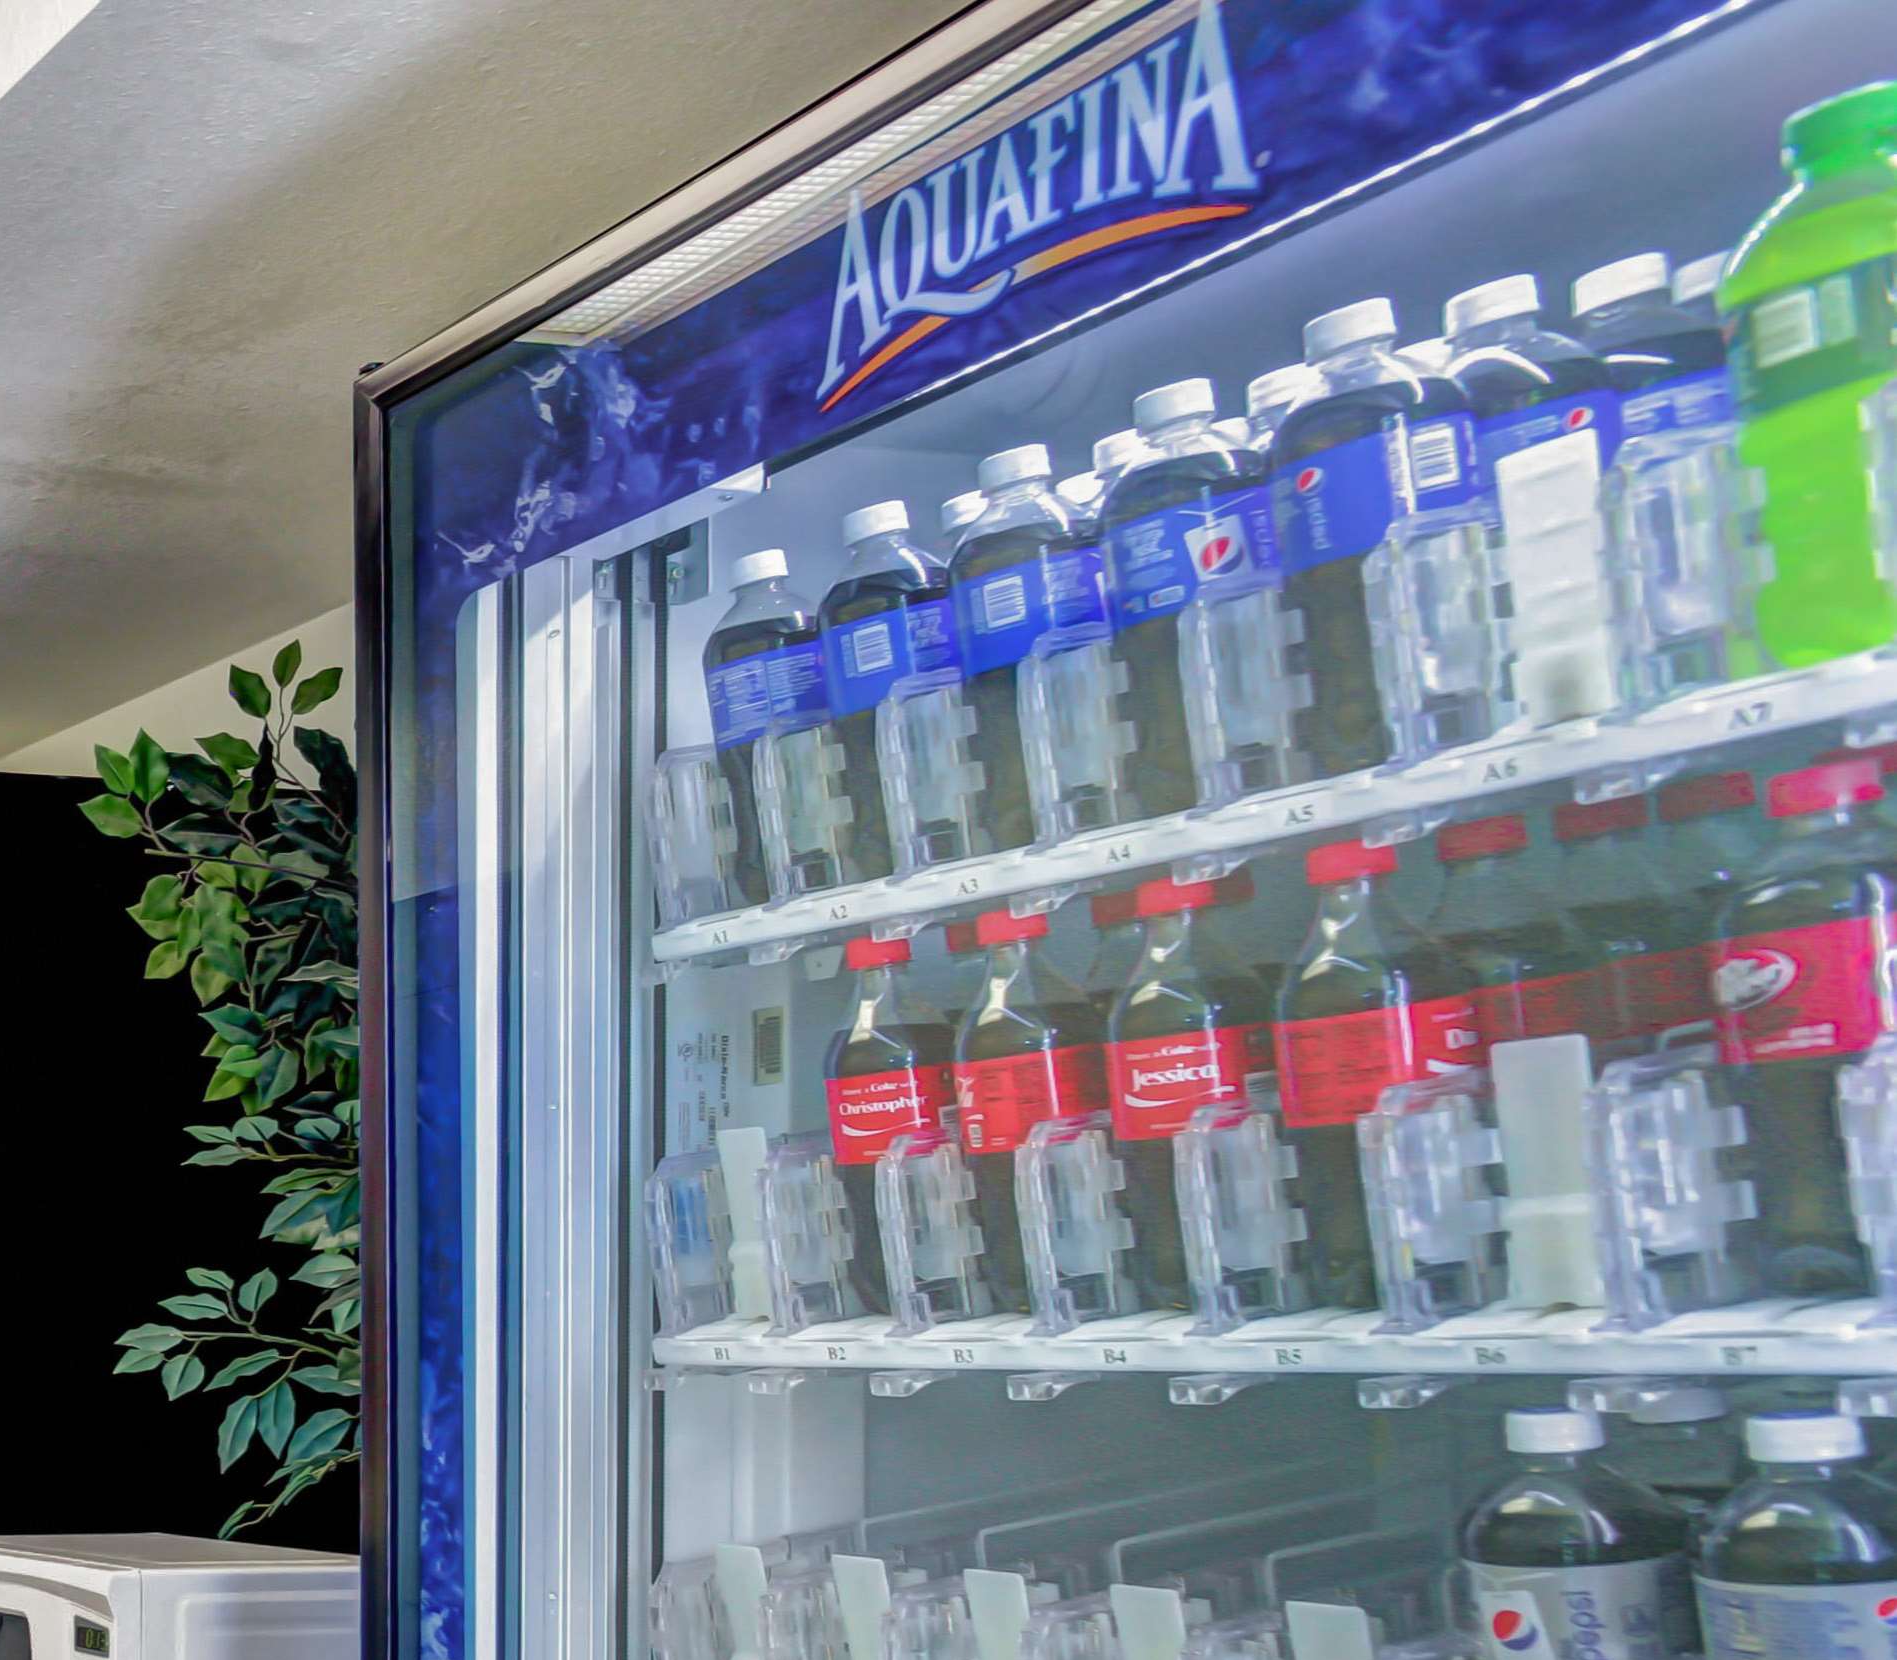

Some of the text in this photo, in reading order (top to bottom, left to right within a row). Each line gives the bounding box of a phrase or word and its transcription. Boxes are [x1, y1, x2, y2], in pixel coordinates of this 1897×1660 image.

[816, 0, 1260, 400] AQUAFINA
[1483, 758, 1518, 782] A6
[1285, 804, 1314, 826] A5
[1106, 844, 1131, 863] A4
[956, 878, 979, 896] A3
[828, 905, 848, 921] A2
[712, 930, 728, 945] A1
[1132, 1062, 1220, 1092] Jessica
[839, 1096, 928, 1116] Christopher
[714, 1347, 730, 1360] B1
[828, 1347, 846, 1360] B2
[953, 1349, 975, 1363] B3
[1103, 1349, 1127, 1363] B4
[1275, 1349, 1302, 1364] B5
